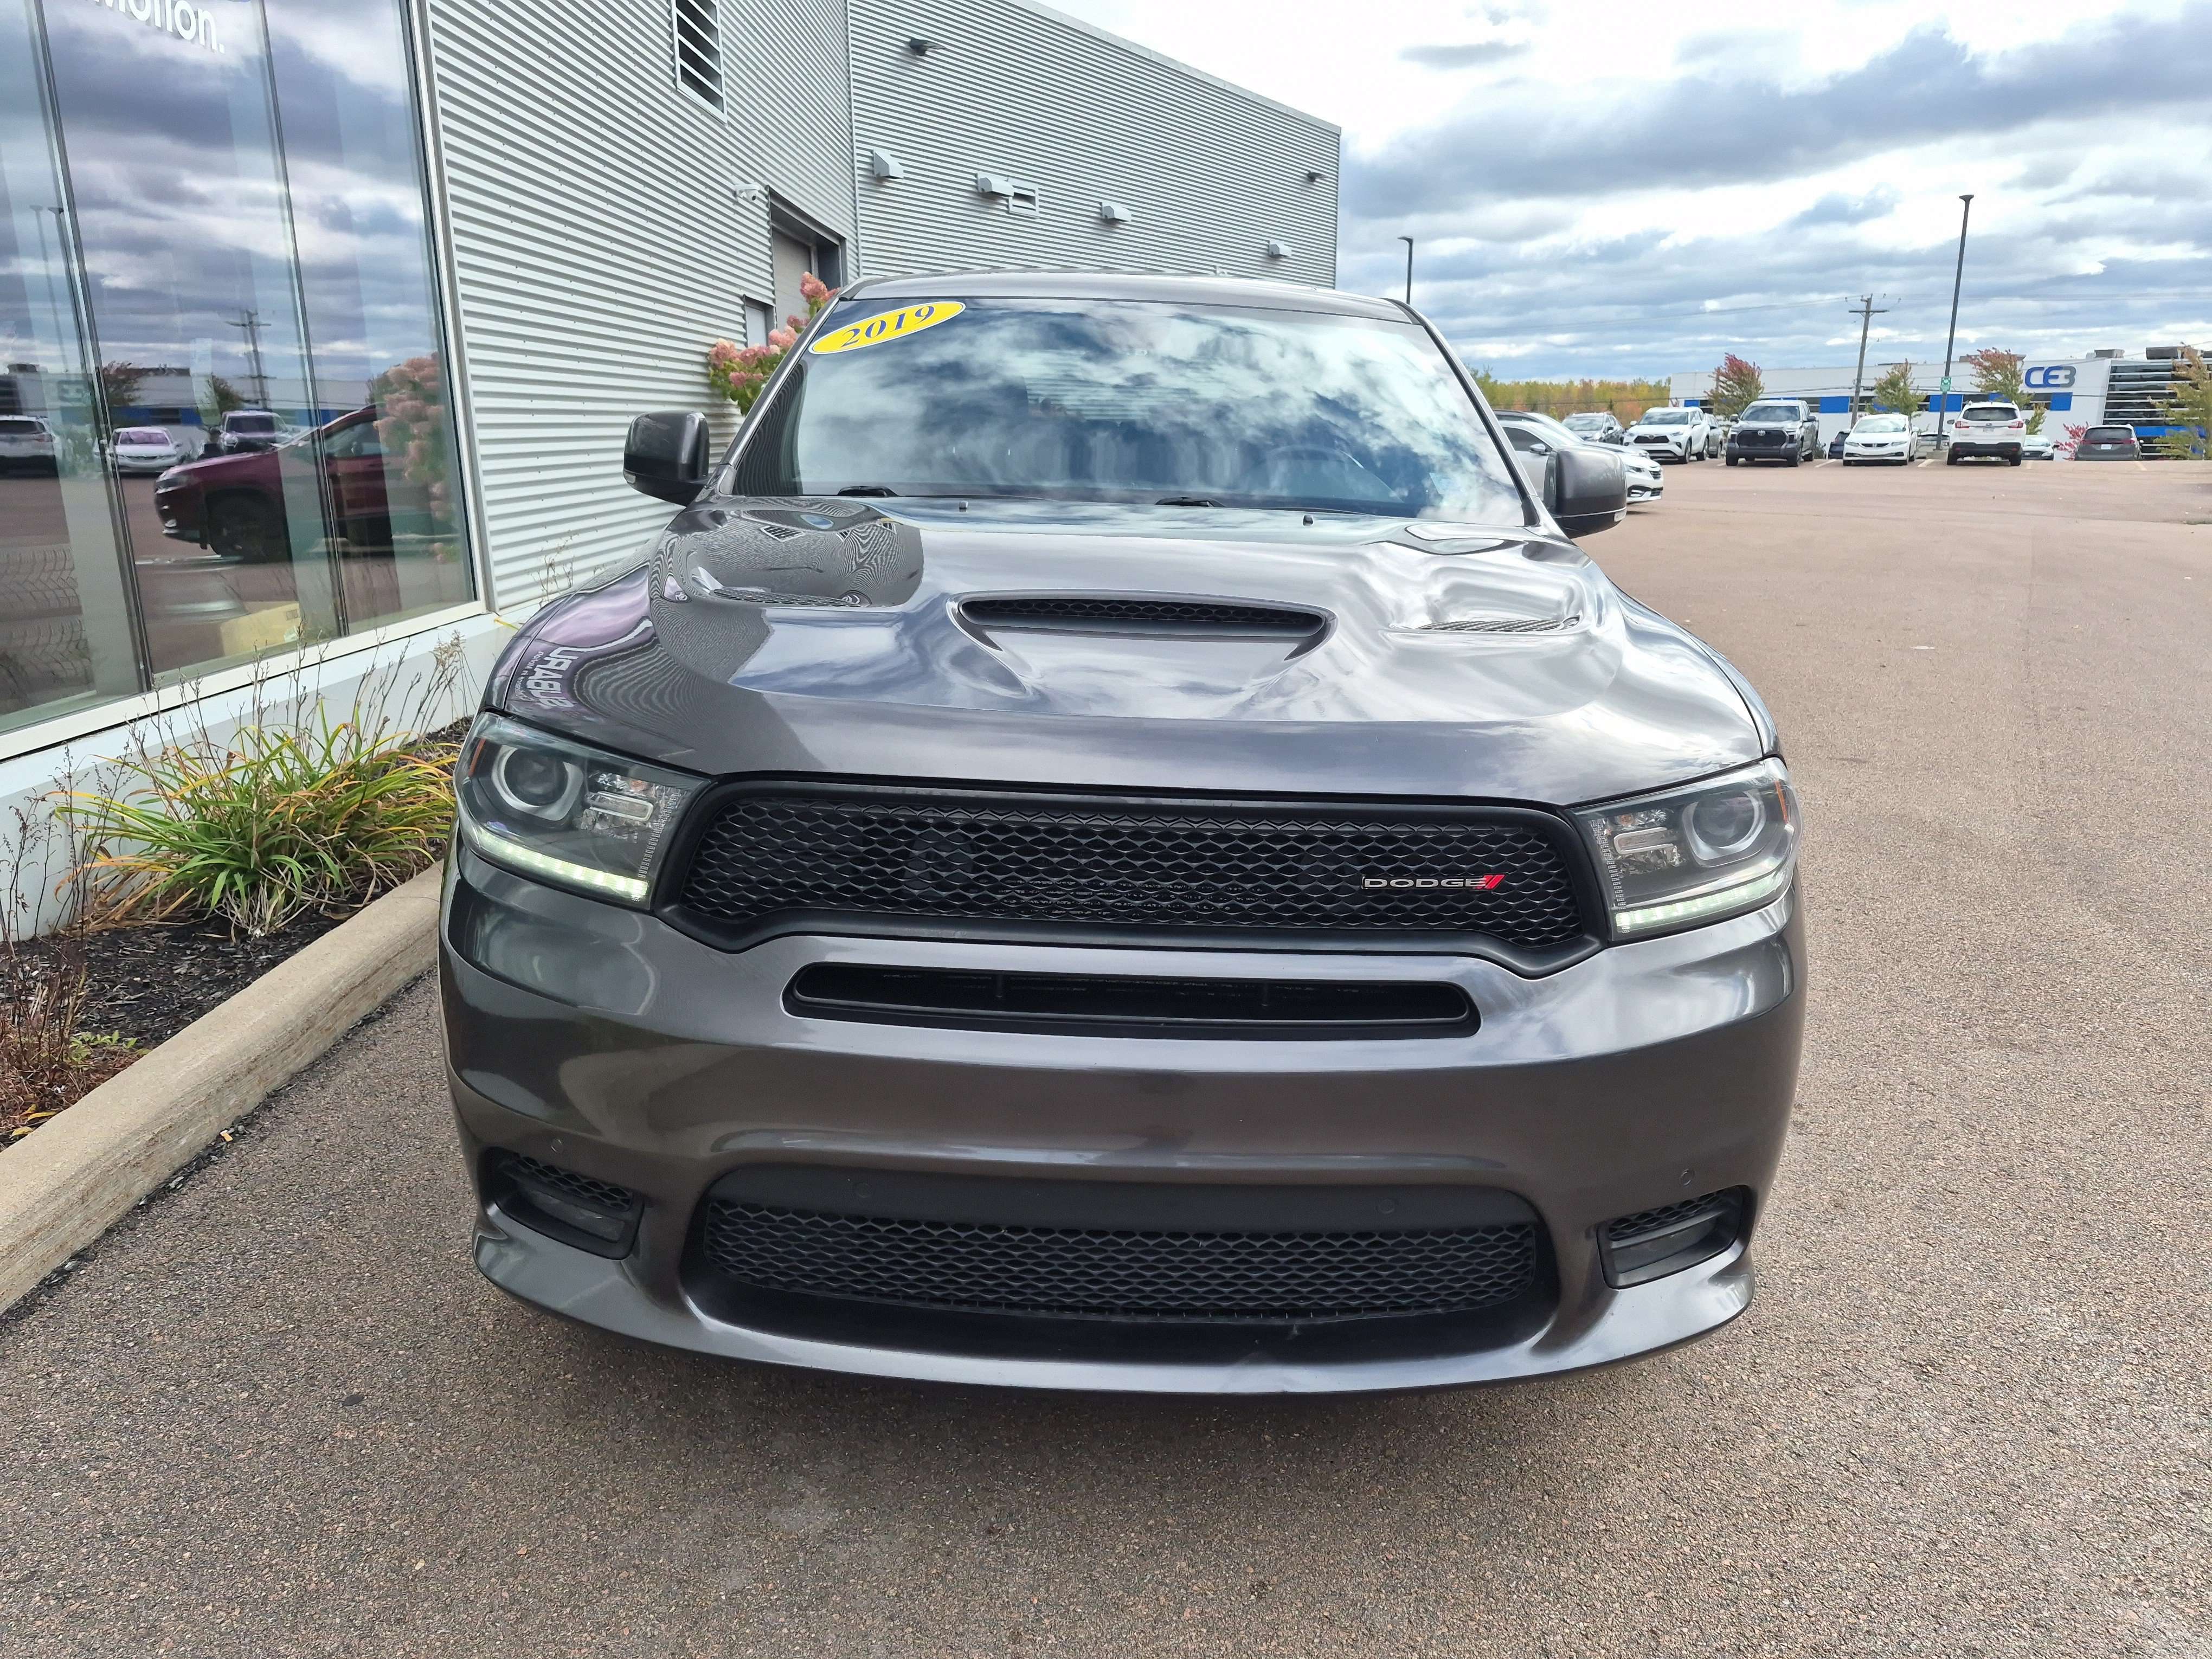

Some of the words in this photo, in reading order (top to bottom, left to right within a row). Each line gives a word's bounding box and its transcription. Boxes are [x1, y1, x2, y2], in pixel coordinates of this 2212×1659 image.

[841, 306, 935, 348] 2019
[2025, 365, 2076, 388] CE3
[1364, 878, 1487, 888] DODGE
